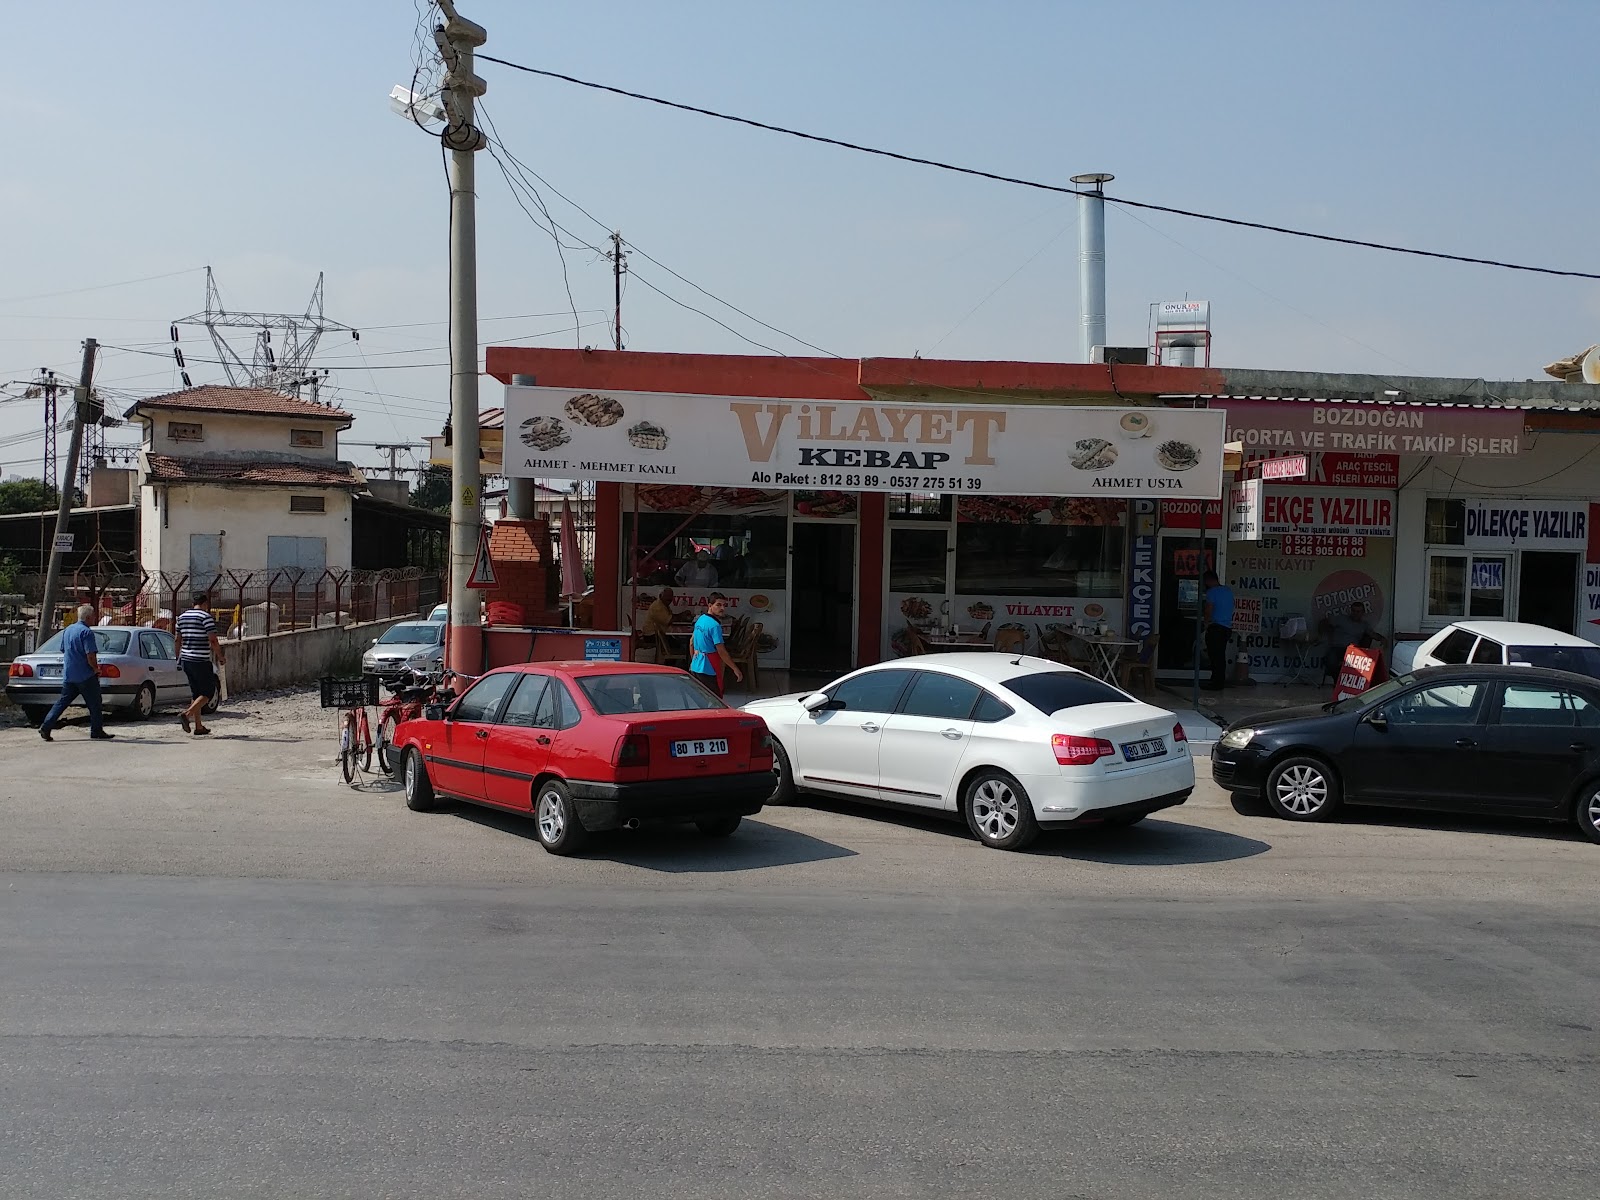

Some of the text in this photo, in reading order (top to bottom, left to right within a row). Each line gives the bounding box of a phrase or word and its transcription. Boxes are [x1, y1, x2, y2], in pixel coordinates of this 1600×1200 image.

[1313, 406, 1424, 429] BOZDOĞAN
[1226, 424, 1518, 457] İGORTA VE TRAFİK TAKİP İŞLERİ
[798, 448, 950, 469] KEBAP
[524, 458, 569, 470] AHMET
[580, 461, 635, 473] MEHMET
[638, 464, 677, 475] KANLI
[1336, 461, 1394, 474] ARAÇ TESCİL
[752, 471, 771, 484] Alo
[775, 472, 810, 485] Paket
[820, 473, 840, 485] 812
[844, 474, 861, 486] 83
[863, 474, 879, 487] 89
[889, 476, 919, 488] 0537
[922, 476, 944, 488] 275
[948, 477, 962, 489] 51
[966, 478, 982, 489] 39
[1091, 477, 1184, 489] AHMET USTA
[1332, 474, 1397, 486] İŞLERİ YAPILIR
[1265, 496, 1392, 531] EKÇE YAZILIR
[1467, 503, 1585, 544] DİLEKÇE YAZILIR
[1256, 536, 1364, 550] CEP: 0 532 714 16 88
[1285, 546, 1364, 556] 0 545 905 01 00
[1274, 558, 1316, 571] KAYIT
[1471, 564, 1503, 588] AÇIK
[672, 593, 740, 608] VİLAT
[1233, 598, 1261, 612] İLEKÇE
[1238, 656, 1280, 668] OSYA
[1344, 651, 1373, 673] DİLEKÇE
[1340, 674, 1367, 690] YAZILIR
[676, 740, 726, 755] 80 FB 210
[1128, 745, 1139, 756] 80
[1140, 743, 1150, 754] HD
